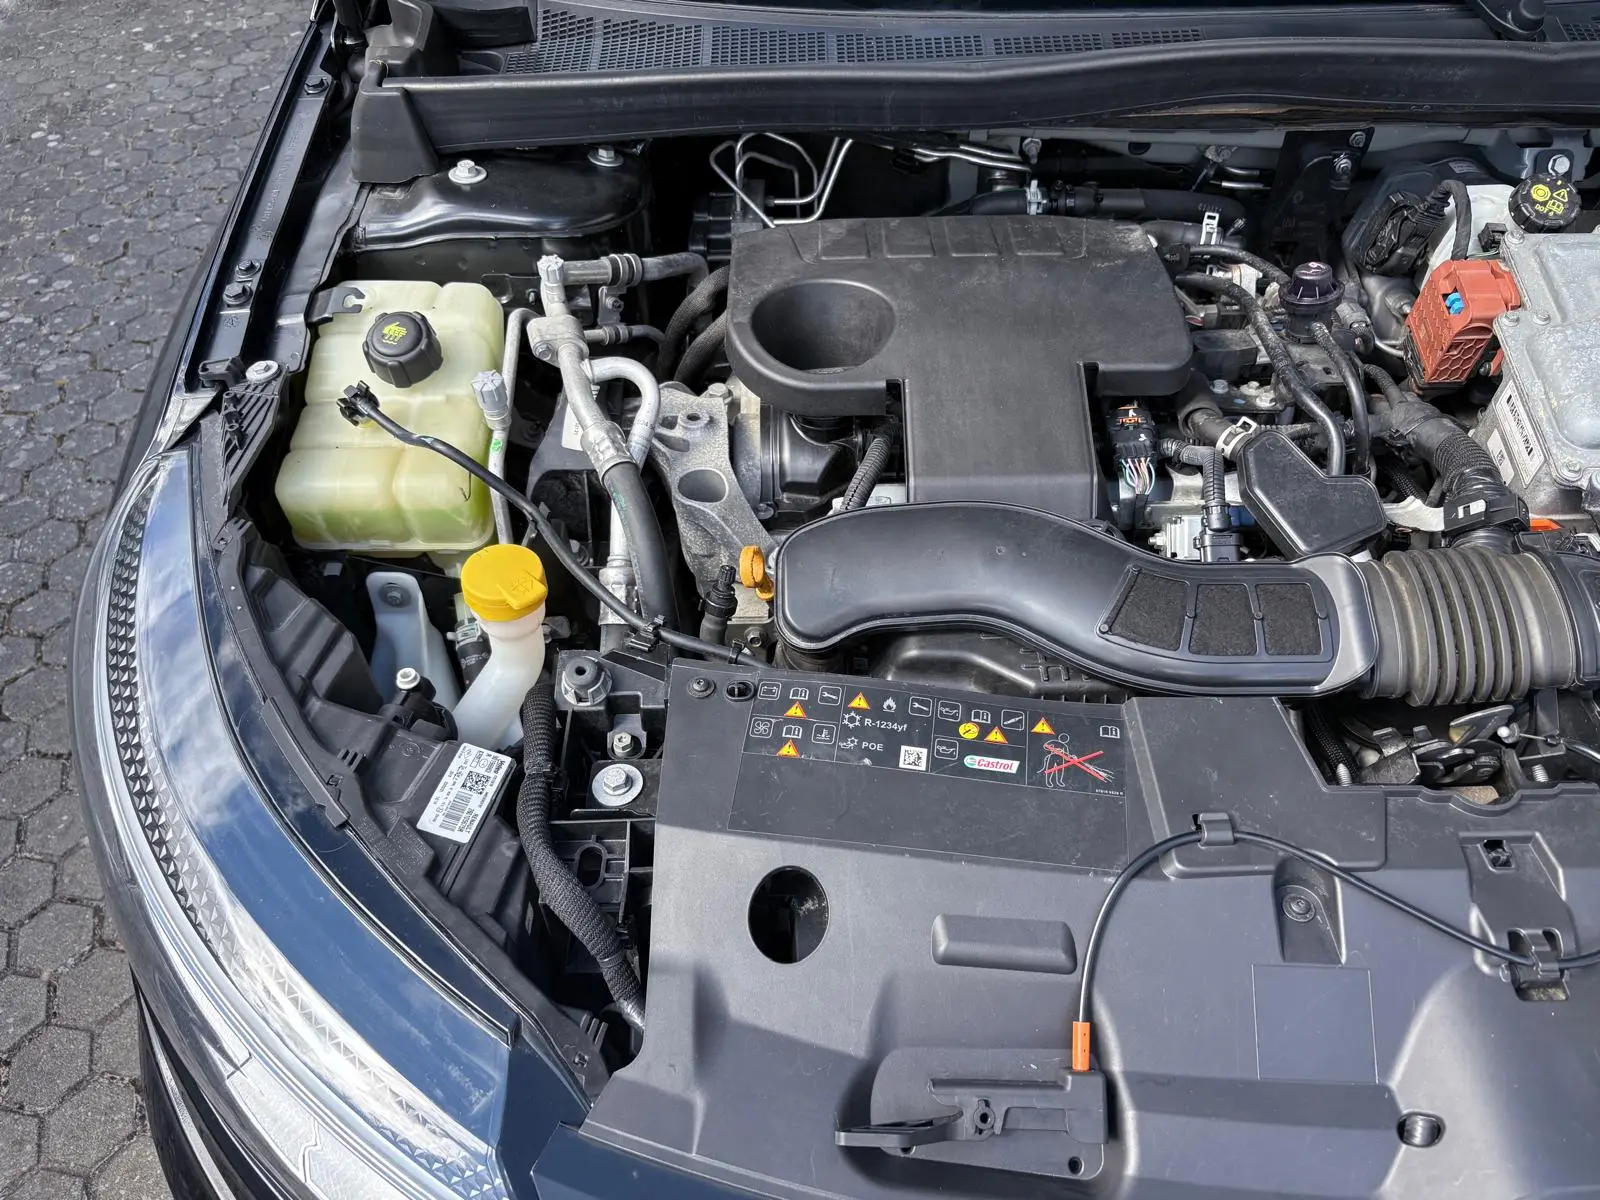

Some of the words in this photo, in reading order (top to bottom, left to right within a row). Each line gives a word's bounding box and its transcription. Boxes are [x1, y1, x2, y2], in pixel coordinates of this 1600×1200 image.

[1534, 203, 1548, 213] DOT
[864, 718, 908, 733] R-1234yf
[861, 741, 884, 752] POE
[977, 758, 1014, 771] Castrol
